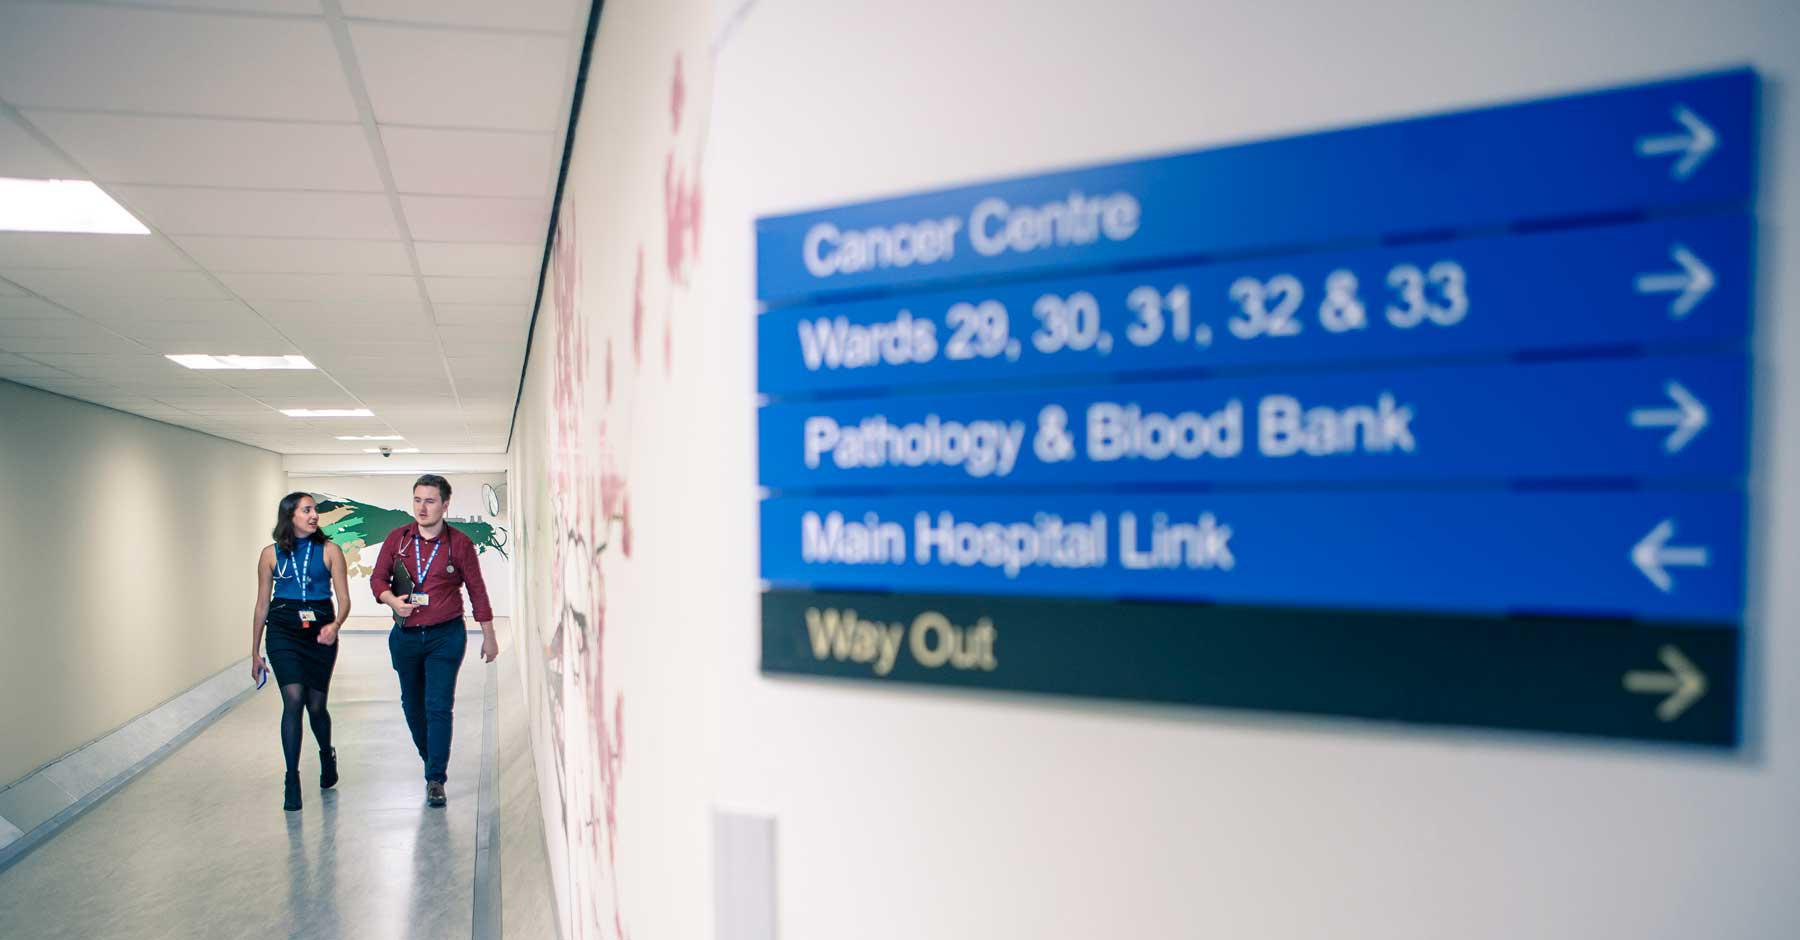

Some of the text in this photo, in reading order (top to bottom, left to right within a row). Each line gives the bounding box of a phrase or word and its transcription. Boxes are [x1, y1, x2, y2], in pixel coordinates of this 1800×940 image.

[803, 191, 1139, 278] Cancer Centre
[798, 265, 1467, 370] Wards 29, 30, 31, 32 & 33
[804, 393, 1413, 477] Pathology & Blood Bank
[801, 511, 1233, 575] Main Hospital Link
[805, 608, 996, 675] Way Out
